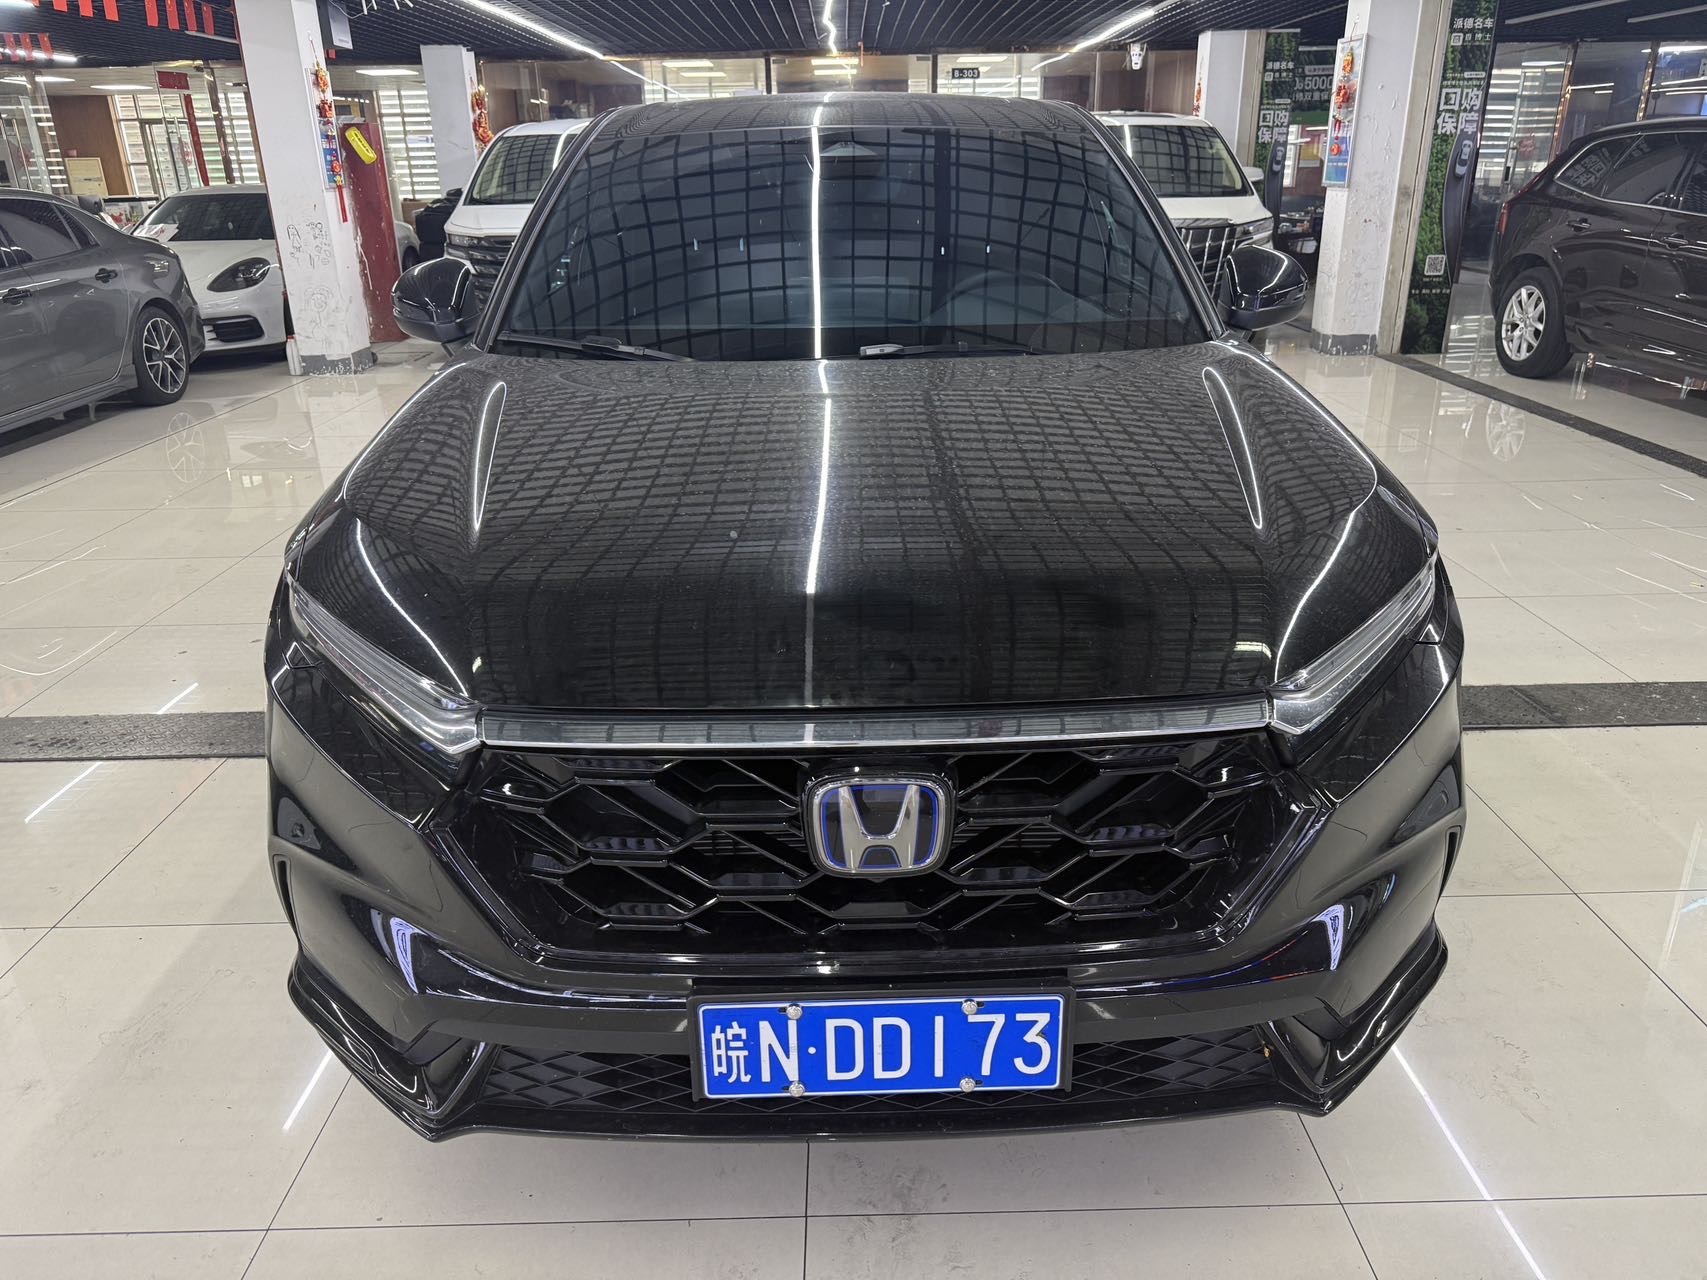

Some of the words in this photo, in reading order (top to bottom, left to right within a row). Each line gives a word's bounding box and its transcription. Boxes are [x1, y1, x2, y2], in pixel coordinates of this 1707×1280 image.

[1453, 17, 1494, 29] 派德名车
[1439, 88, 1483, 111] 回购
[1259, 110, 1289, 127] 回购
[1437, 112, 1479, 135] 保障
[1257, 127, 1287, 143] 保障
